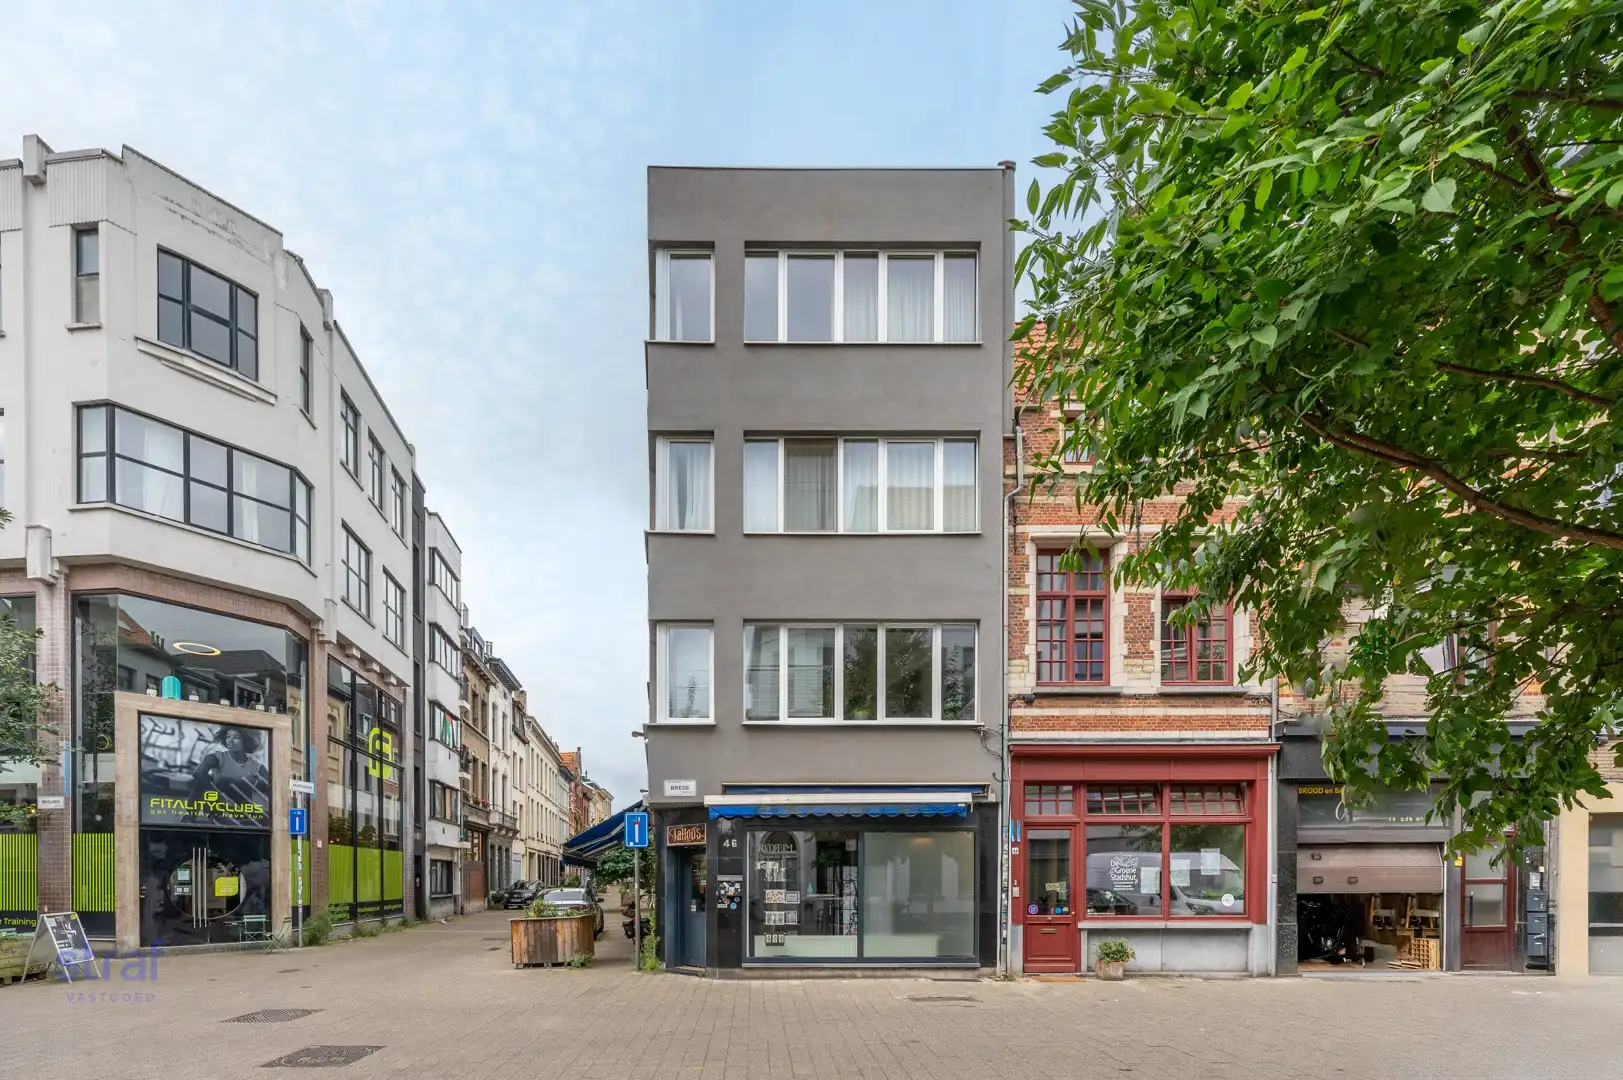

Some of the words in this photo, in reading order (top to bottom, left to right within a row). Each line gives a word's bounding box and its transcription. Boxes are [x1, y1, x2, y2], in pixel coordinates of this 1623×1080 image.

[1298, 787, 1324, 795] BROOD
[150, 798, 264, 813] FITALITYCLUBS
[171, 809, 210, 818] healthy
[723, 839, 738, 848] 46
[1115, 866, 1137, 874] Groene
[1110, 873, 1137, 881] Stadshut
[4, 917, 37, 927] Training
